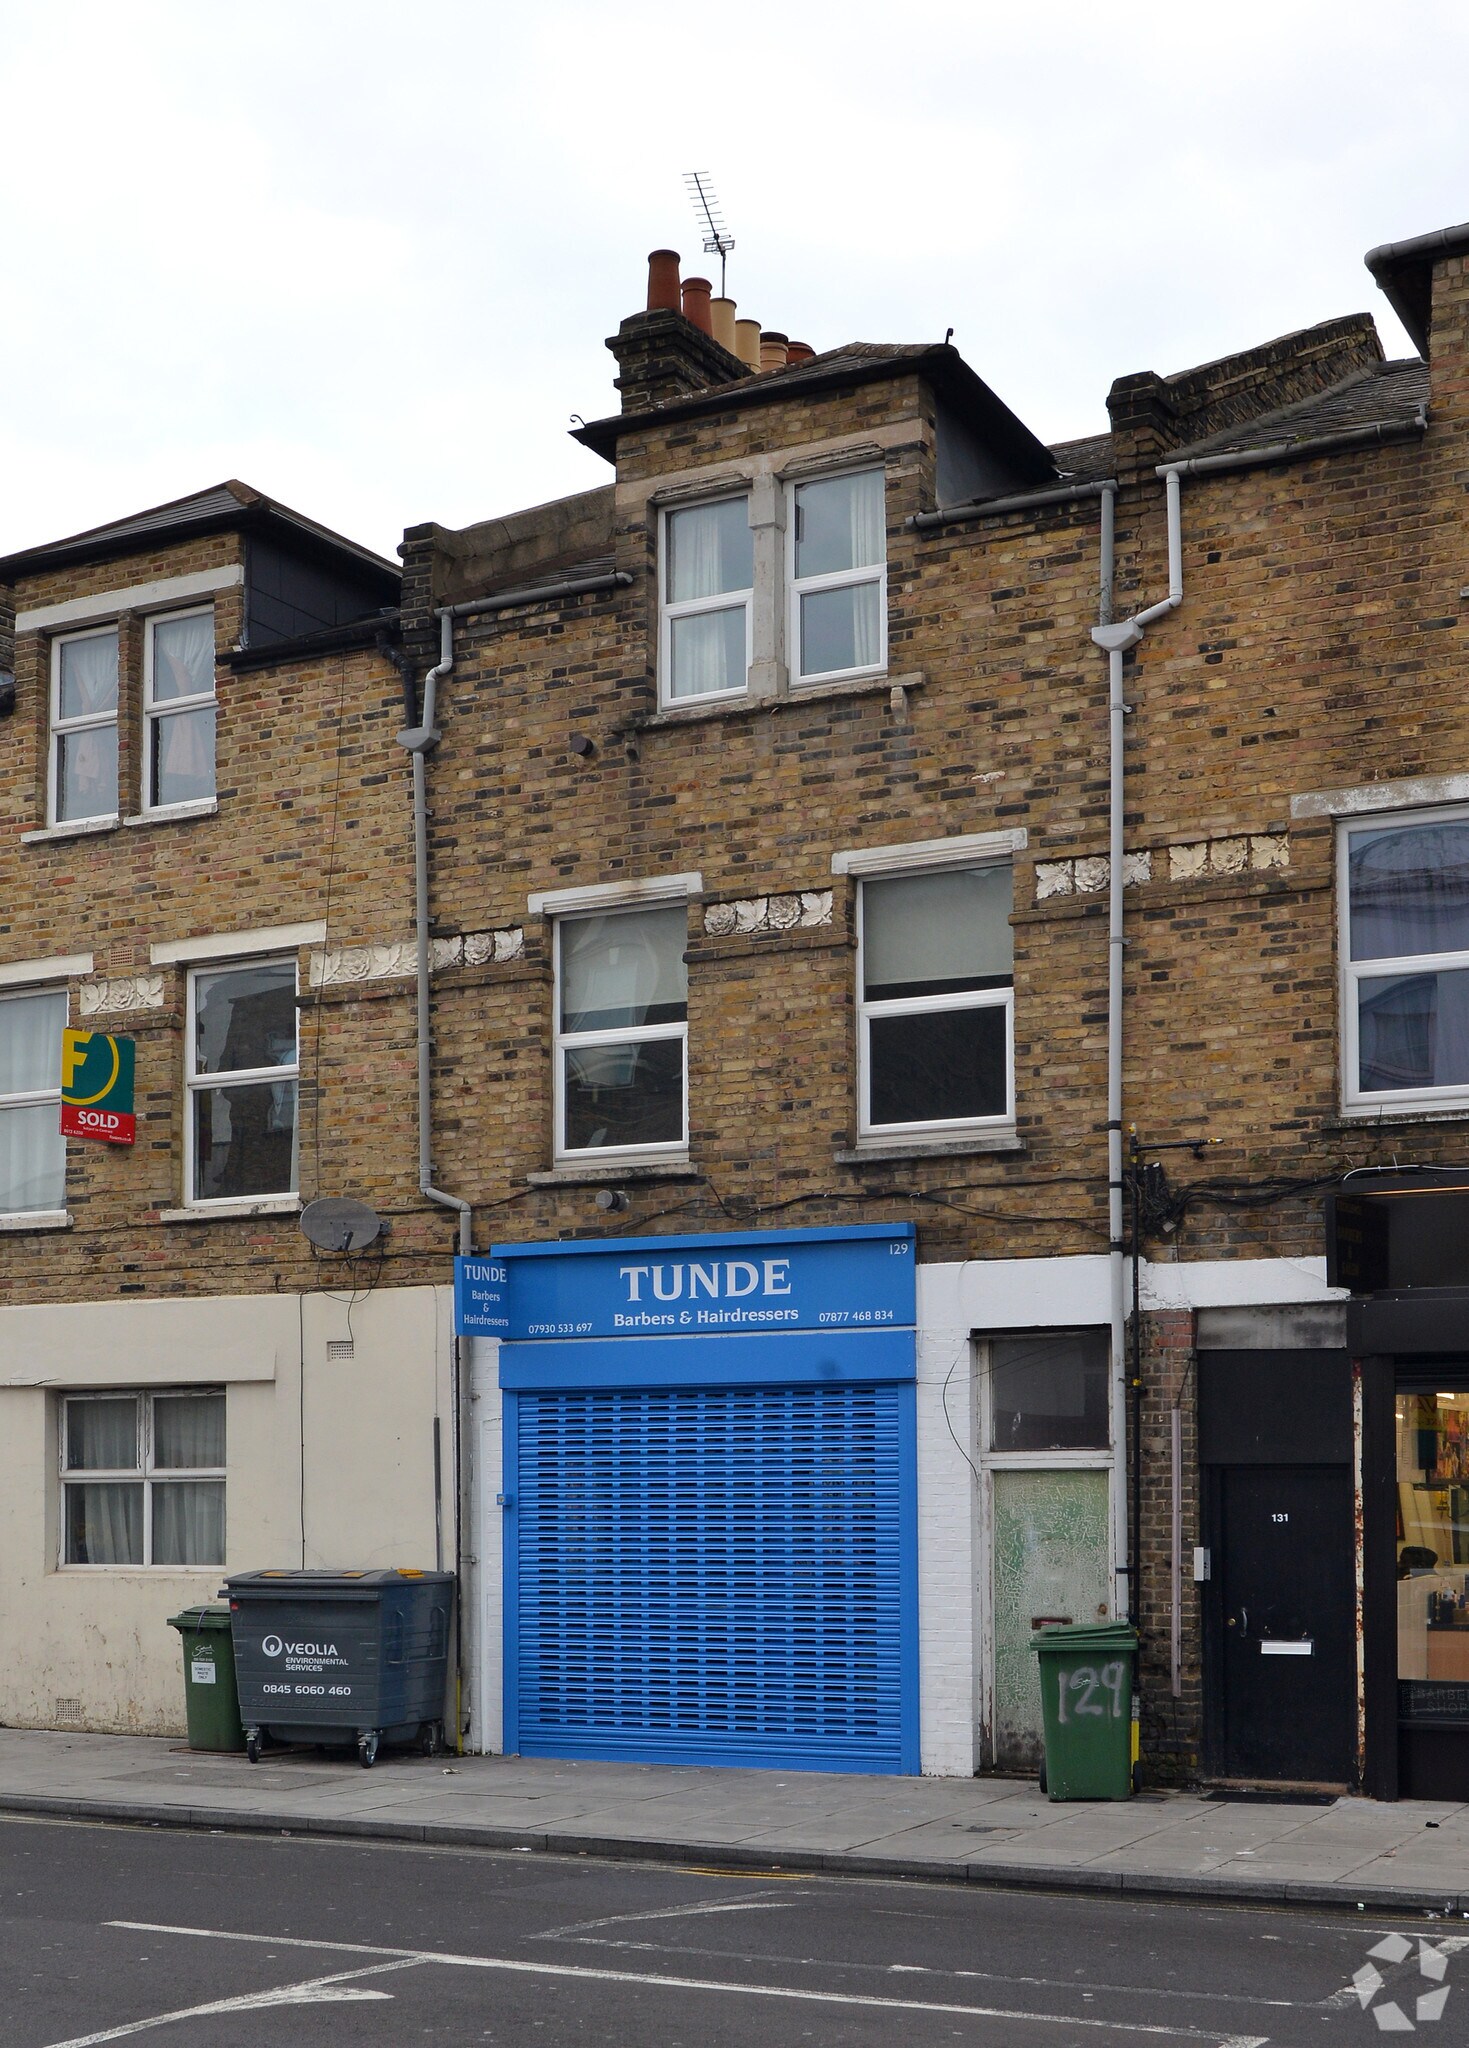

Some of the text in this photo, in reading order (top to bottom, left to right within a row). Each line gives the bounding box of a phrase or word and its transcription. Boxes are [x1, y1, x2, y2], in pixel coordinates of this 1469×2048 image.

[77, 1110, 120, 1129] SOLD
[889, 1243, 909, 1255] 129
[463, 1264, 507, 1283] TUNDE
[619, 1258, 792, 1302] TUNDE
[471, 1289, 501, 1302] Barbers
[482, 1302, 490, 1313] &
[463, 1313, 509, 1327] Hairdressers
[614, 1307, 799, 1327] Barbers & Hairdressers
[818, 1310, 894, 1323] 07877 468 834
[528, 1322, 593, 1334] 07930 533 697
[1271, 1513, 1289, 1523] 131
[284, 1642, 338, 1656] VEOLIA
[285, 1657, 349, 1666] ENVIRONMENTAL
[285, 1664, 323, 1672] SERVICES
[262, 1684, 352, 1696] 0845 6060 460
[1057, 1660, 1125, 1724] 129
